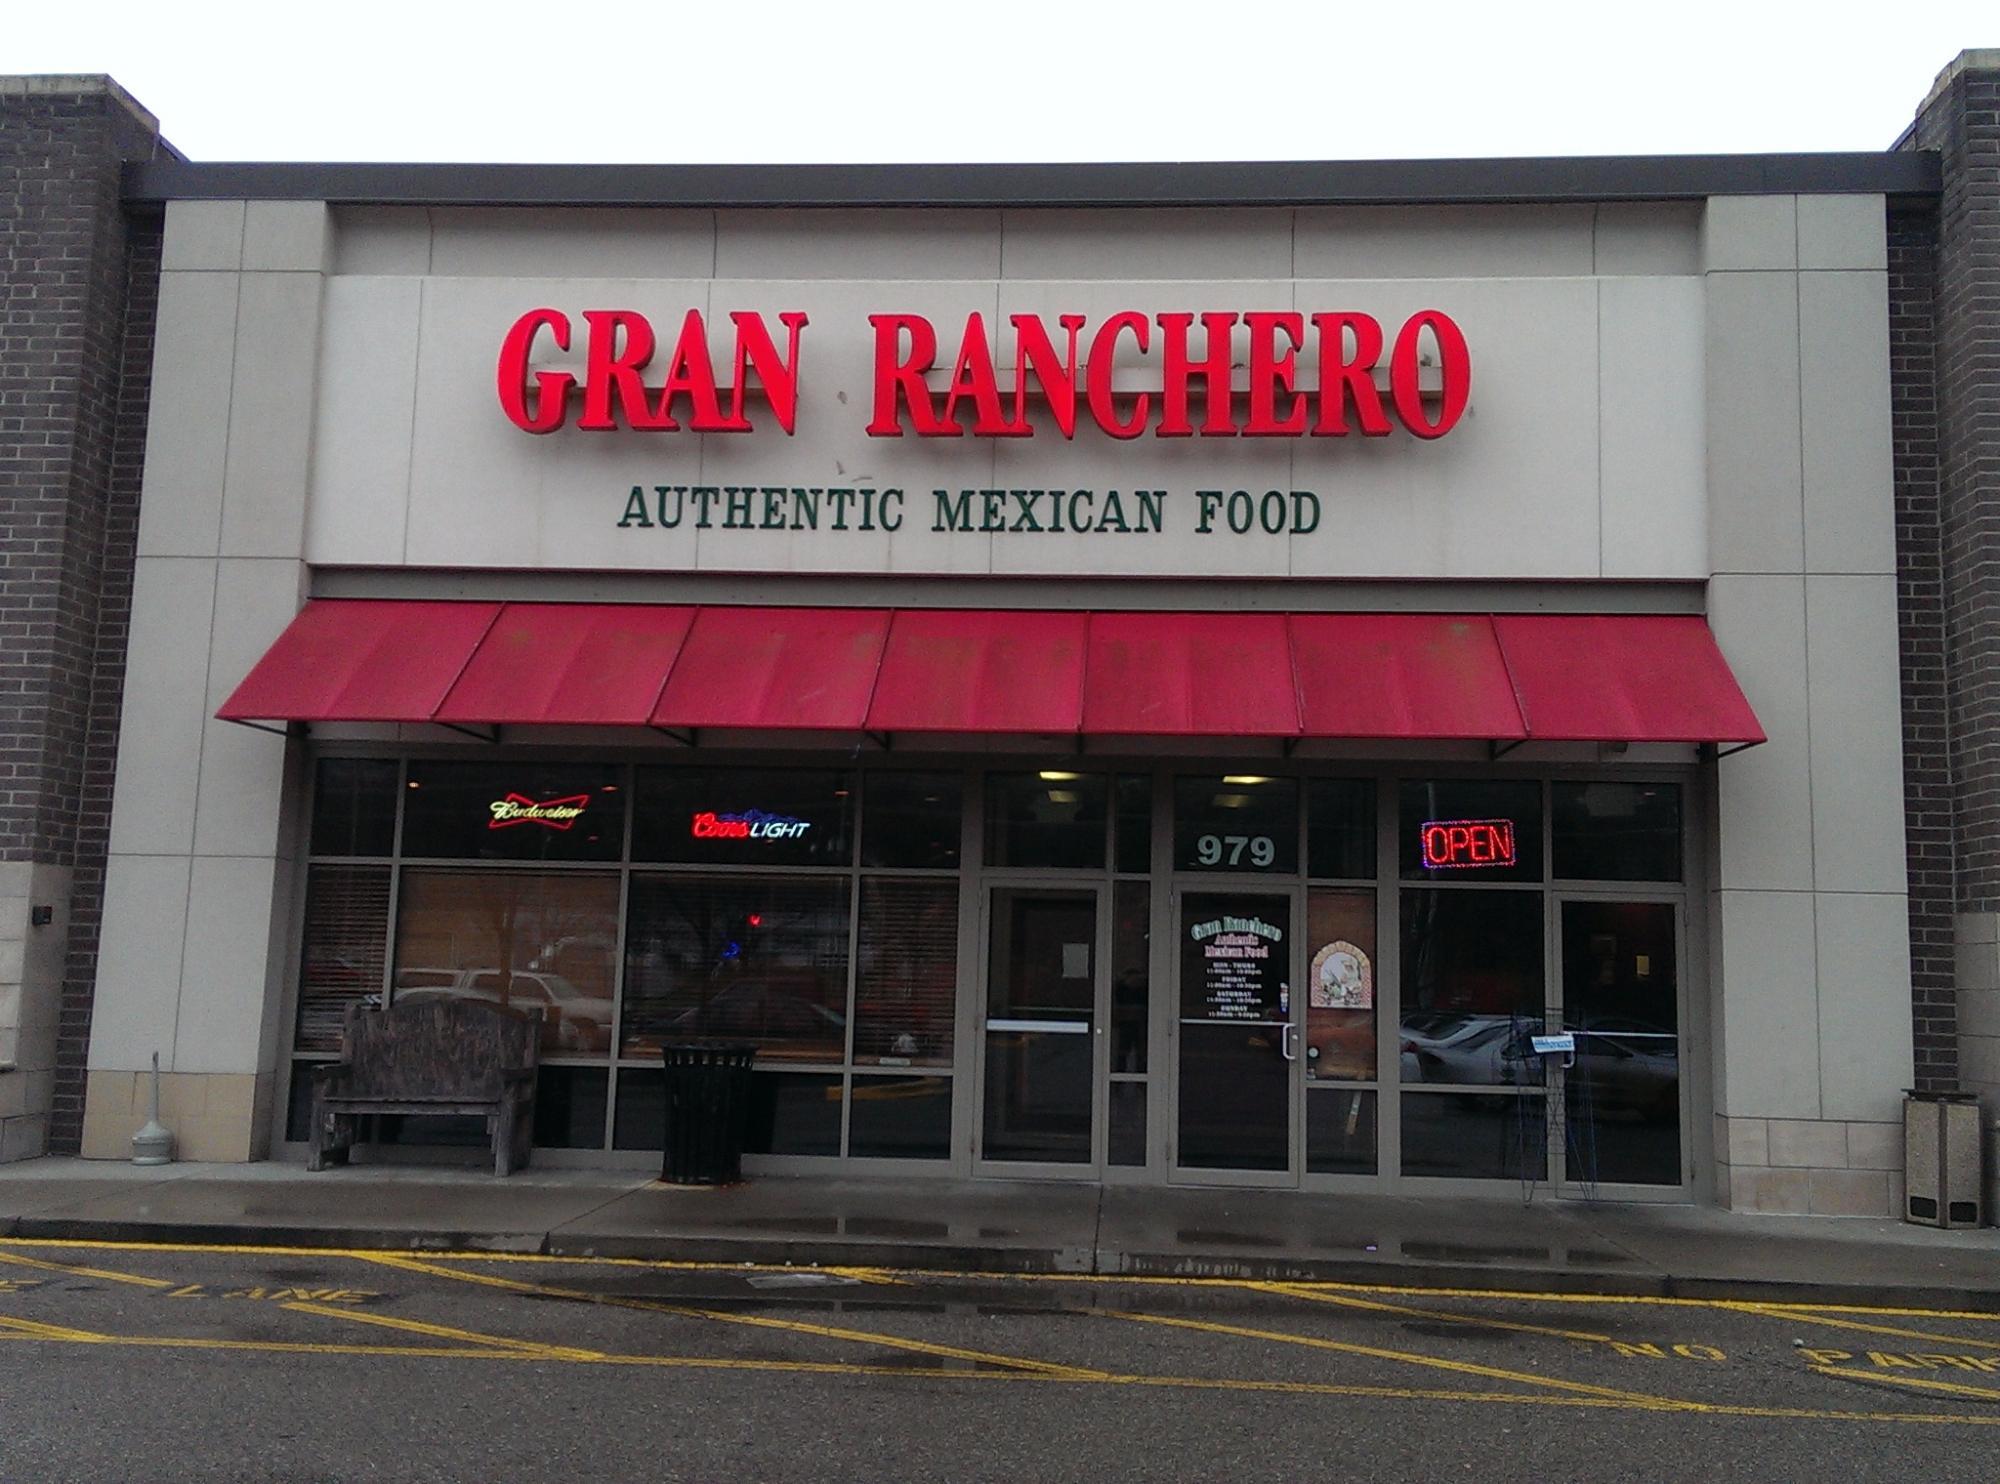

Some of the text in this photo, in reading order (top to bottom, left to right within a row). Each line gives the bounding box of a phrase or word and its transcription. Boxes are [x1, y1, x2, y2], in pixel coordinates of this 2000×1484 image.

[497, 308, 1471, 440] GRAN RANCHERO
[617, 486, 1321, 535] AUTHENTIC MEXICAN FOOD
[490, 800, 586, 820] Budweiser
[692, 811, 811, 839] Coors LIGHT
[1197, 834, 1276, 866] 979
[1425, 825, 1512, 864] OPEN
[1204, 945, 1269, 959] Mexican Food
[167, 1284, 380, 1302] LANE
[1607, 1341, 1727, 1361] NO
